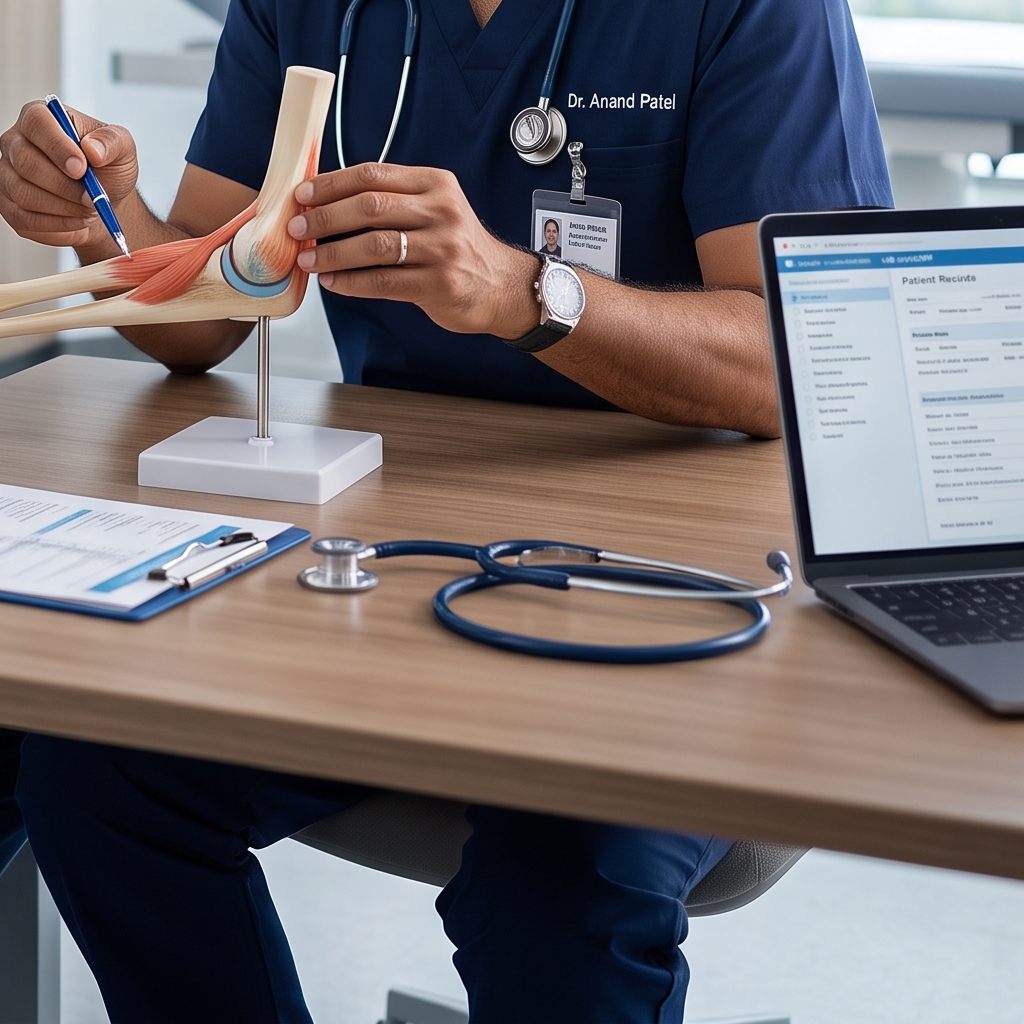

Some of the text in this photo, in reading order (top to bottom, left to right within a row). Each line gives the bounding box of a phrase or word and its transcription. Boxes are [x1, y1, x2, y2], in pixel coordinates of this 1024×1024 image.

[568, 92, 676, 110] Dr. Anand Patel
[902, 275, 936, 285] Patient
